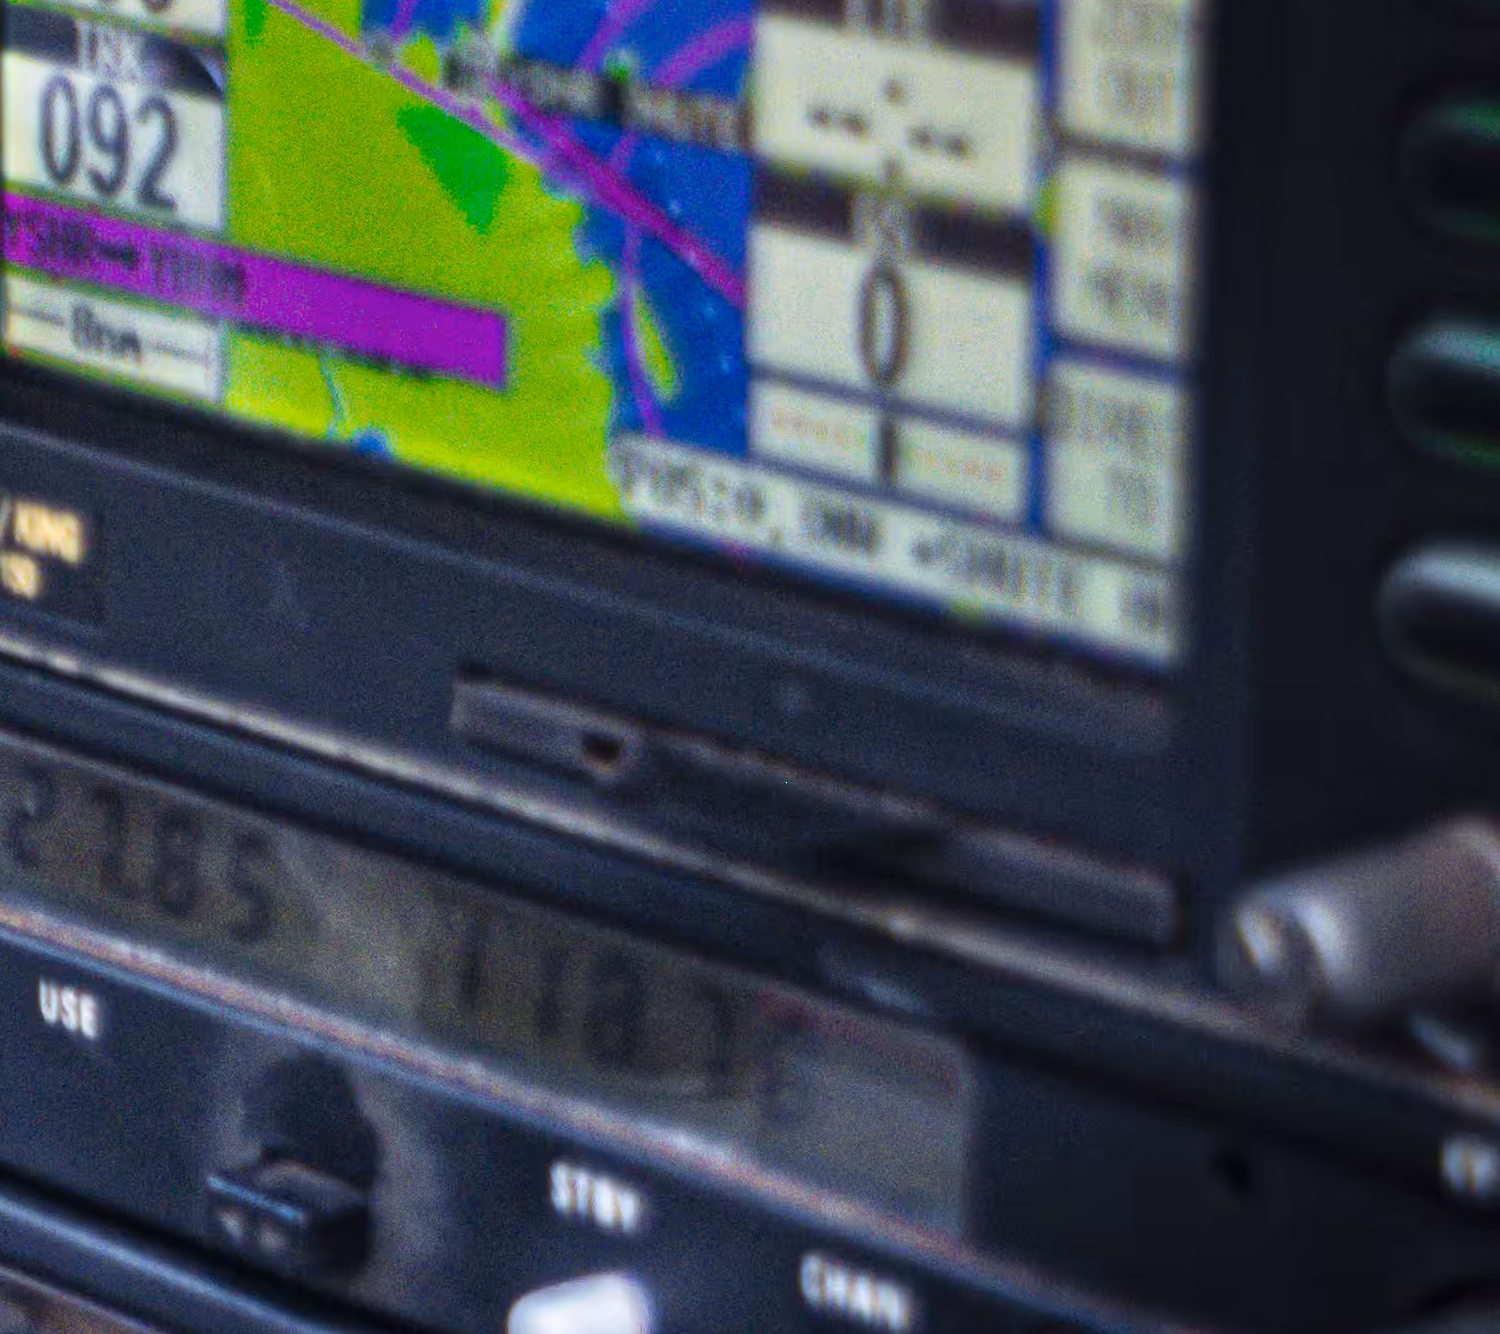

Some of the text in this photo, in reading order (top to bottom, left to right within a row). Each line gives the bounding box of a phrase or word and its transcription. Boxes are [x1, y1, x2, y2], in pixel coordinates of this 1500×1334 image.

[40, 73, 180, 214] 092
[38, 978, 101, 1041] USE
[550, 1157, 646, 1234] STBY
